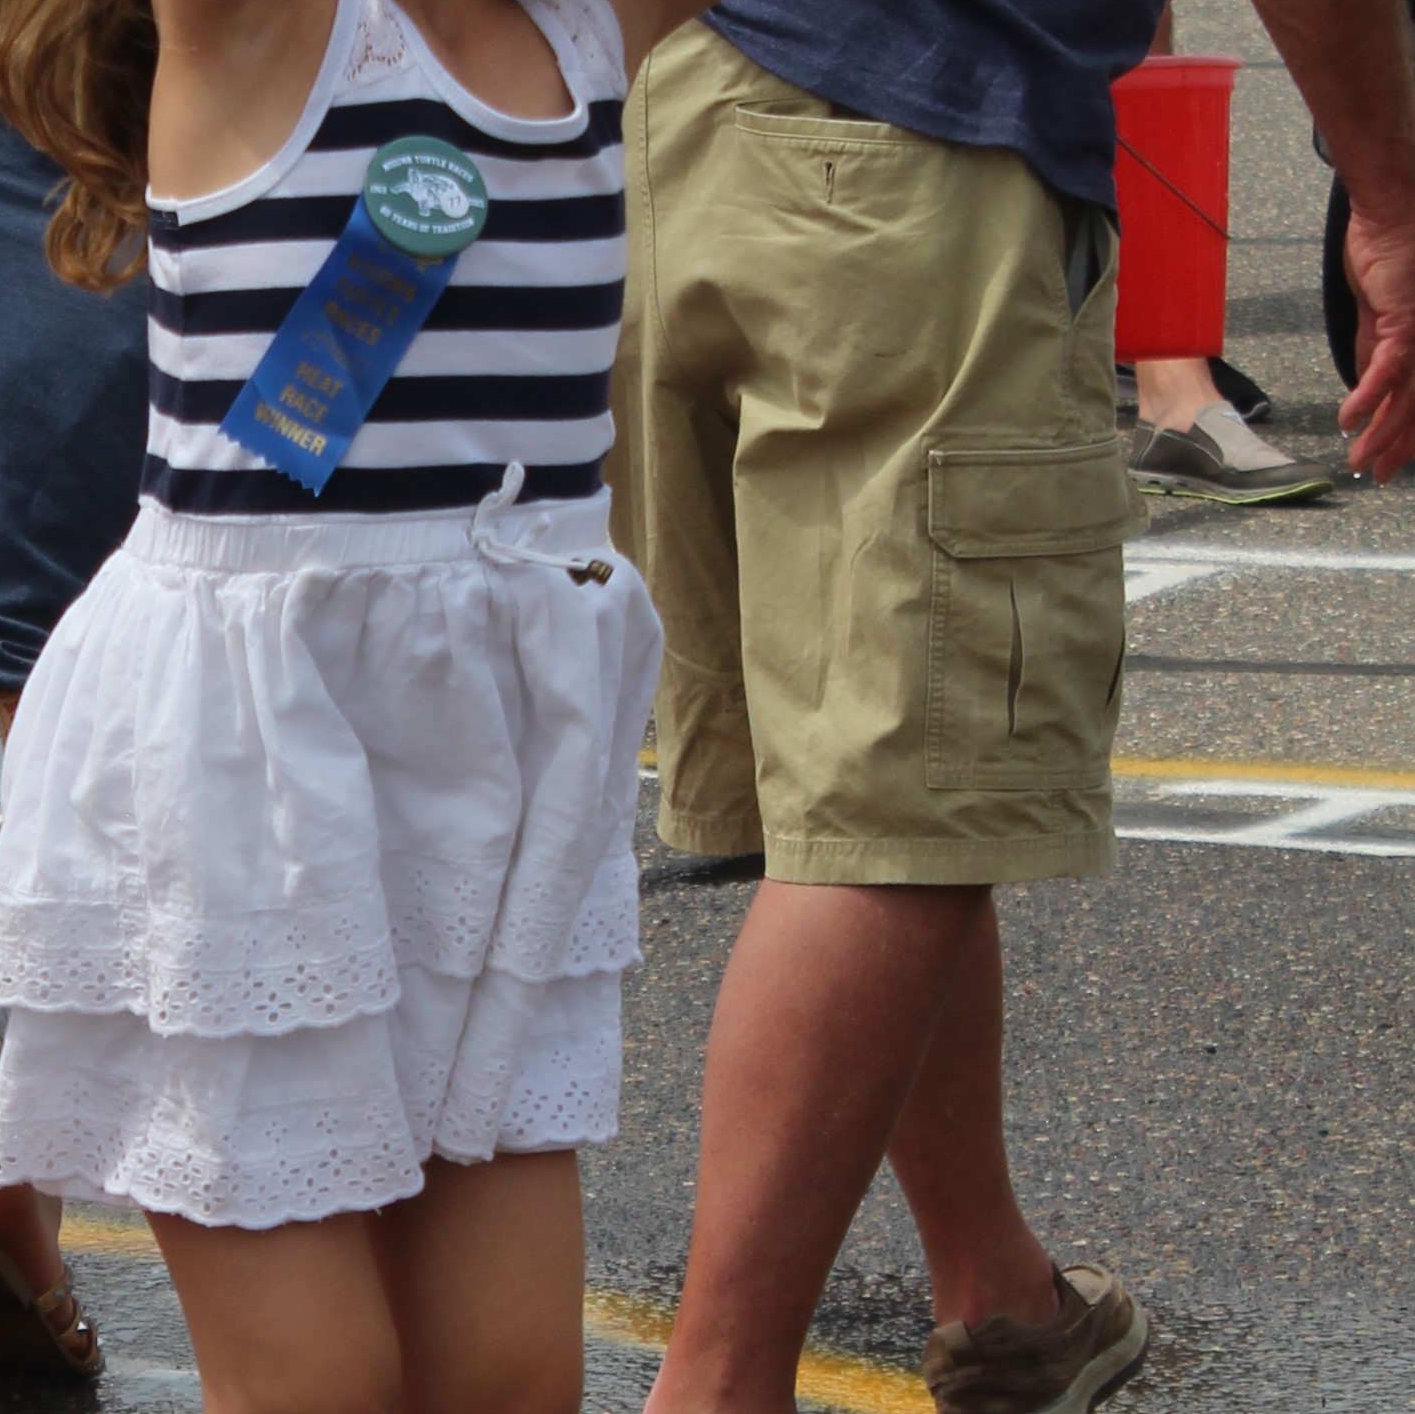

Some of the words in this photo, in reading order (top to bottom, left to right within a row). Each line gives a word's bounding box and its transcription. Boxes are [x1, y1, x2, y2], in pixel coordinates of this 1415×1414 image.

[413, 154, 447, 169] TURTLE
[392, 213, 419, 231] YEARS
[431, 217, 475, 235] TRADITION
[295, 360, 344, 398] HEAT
[278, 384, 329, 425] RACE
[254, 401, 328, 458] WINNER
